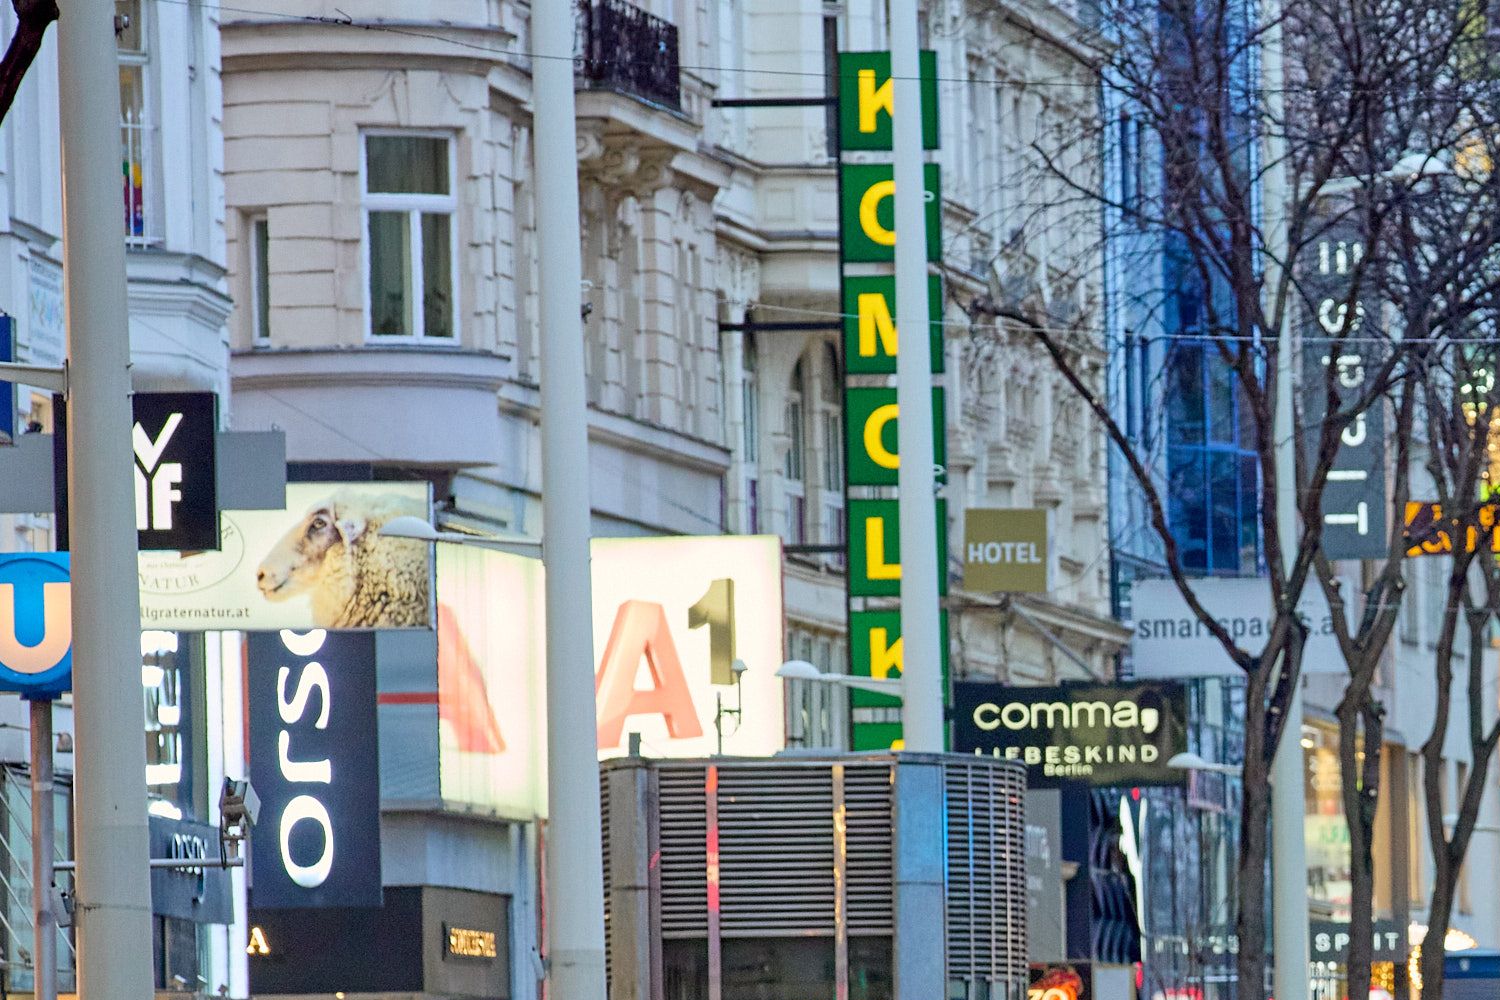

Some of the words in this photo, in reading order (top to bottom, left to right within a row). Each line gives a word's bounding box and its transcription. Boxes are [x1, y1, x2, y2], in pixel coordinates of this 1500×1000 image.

[968, 542, 1041, 563] HOTEL
[595, 577, 735, 750] A1
[973, 700, 1159, 734] comma,
[1043, 762, 1093, 776] Berlin
[1315, 932, 1399, 952] SPIT
